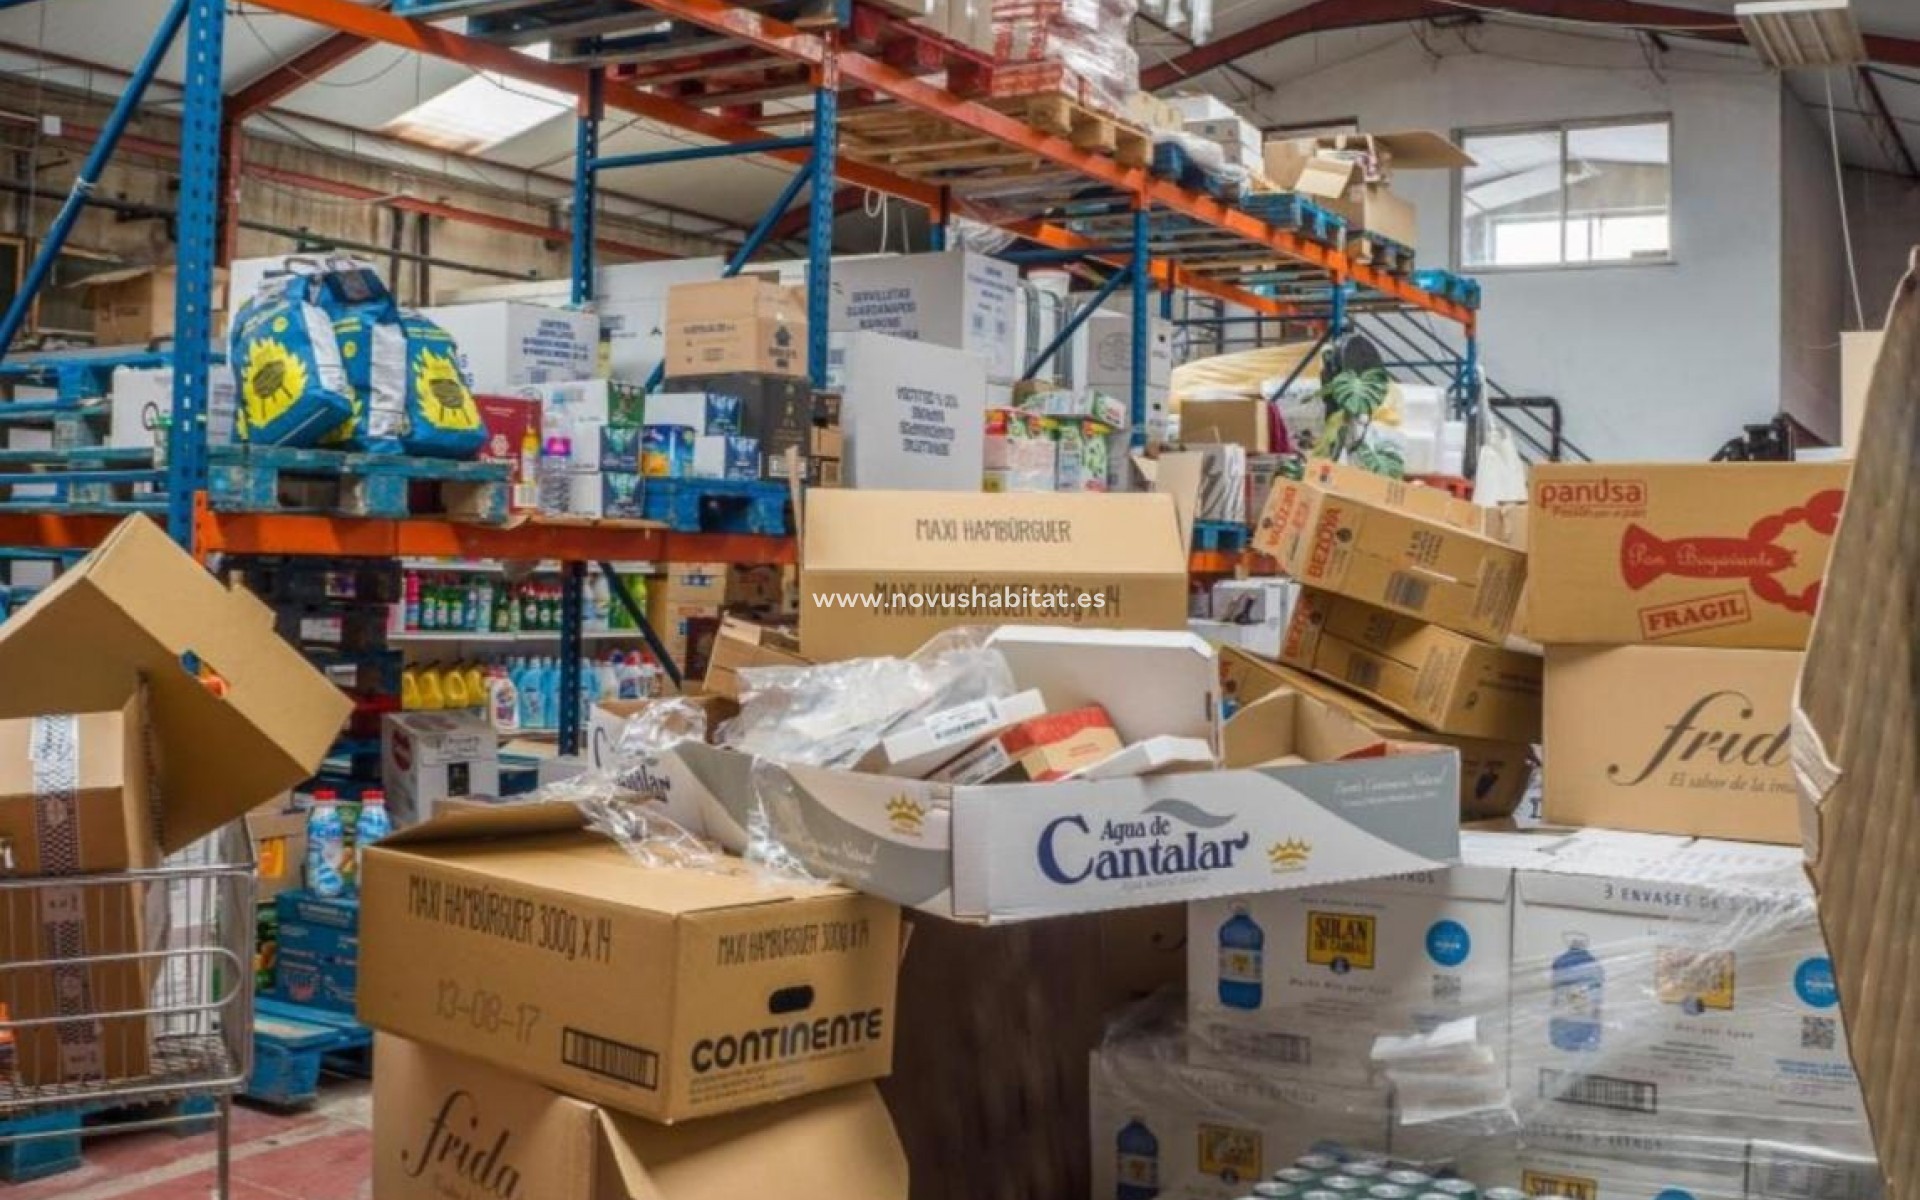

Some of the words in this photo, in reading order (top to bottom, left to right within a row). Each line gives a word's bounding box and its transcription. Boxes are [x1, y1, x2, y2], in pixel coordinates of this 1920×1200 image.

[916, 519, 957, 542] MAXI
[1306, 507, 1342, 580] BEZOYA
[1607, 689, 1792, 787] frid
[1036, 814, 1249, 885] Cantalar
[1100, 820, 1146, 845] Agua
[1150, 816, 1170, 835] de
[409, 874, 441, 920] MAXI
[538, 904, 577, 961] 300g
[597, 918, 612, 965] 14
[1621, 887, 1690, 906] ENVASES
[717, 934, 748, 966] MAXI
[436, 978, 541, 1042] 13-08-17
[691, 1008, 883, 1073] CONTINENTE
[401, 1090, 521, 1199] frida
